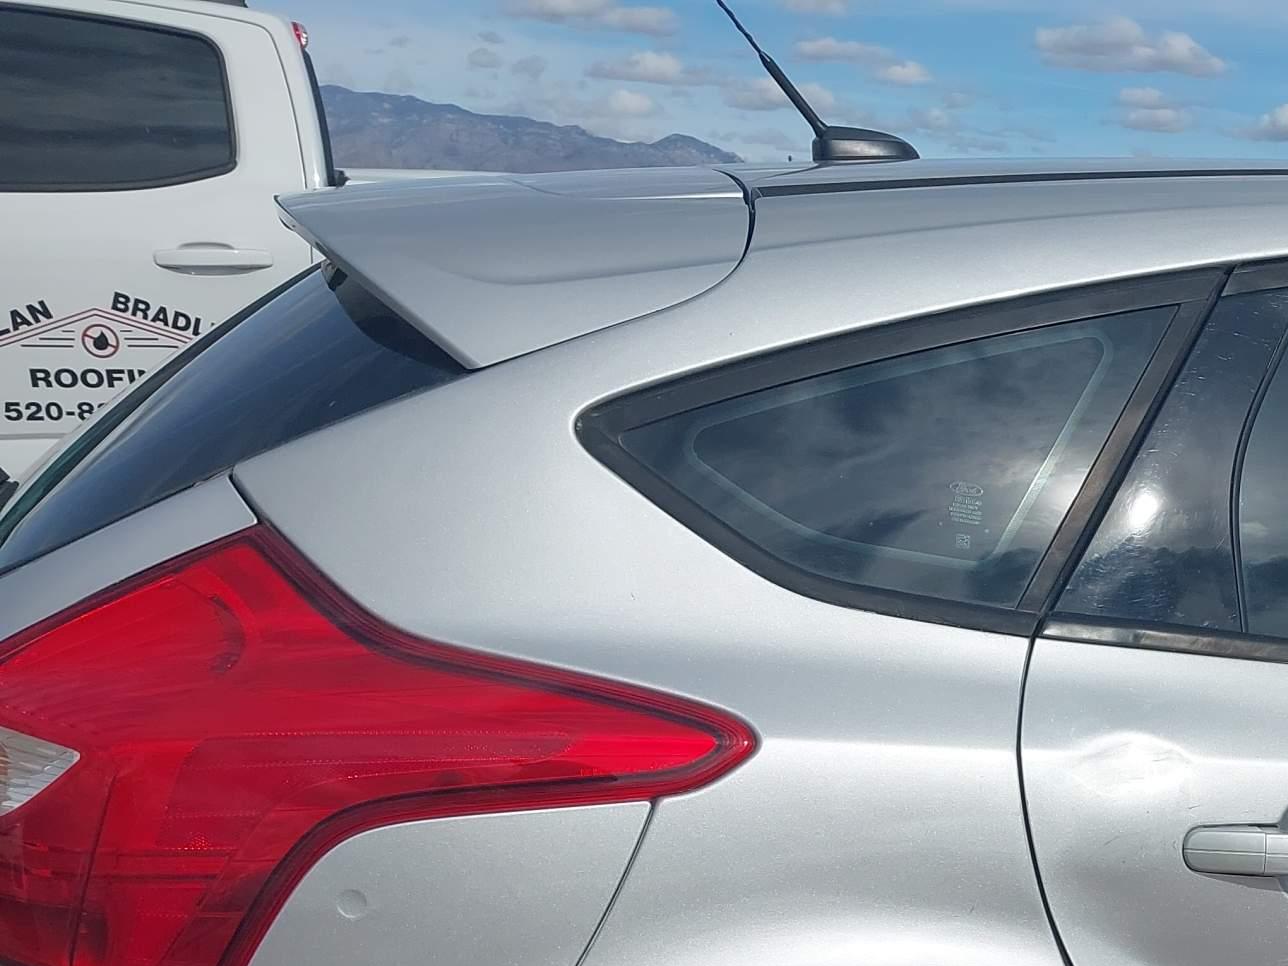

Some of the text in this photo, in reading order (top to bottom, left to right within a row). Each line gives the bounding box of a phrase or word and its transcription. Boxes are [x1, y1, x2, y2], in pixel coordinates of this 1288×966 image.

[111, 291, 208, 336] BRADL
[29, 368, 146, 388] ROOFI
[4, 402, 106, 421] 520-8
